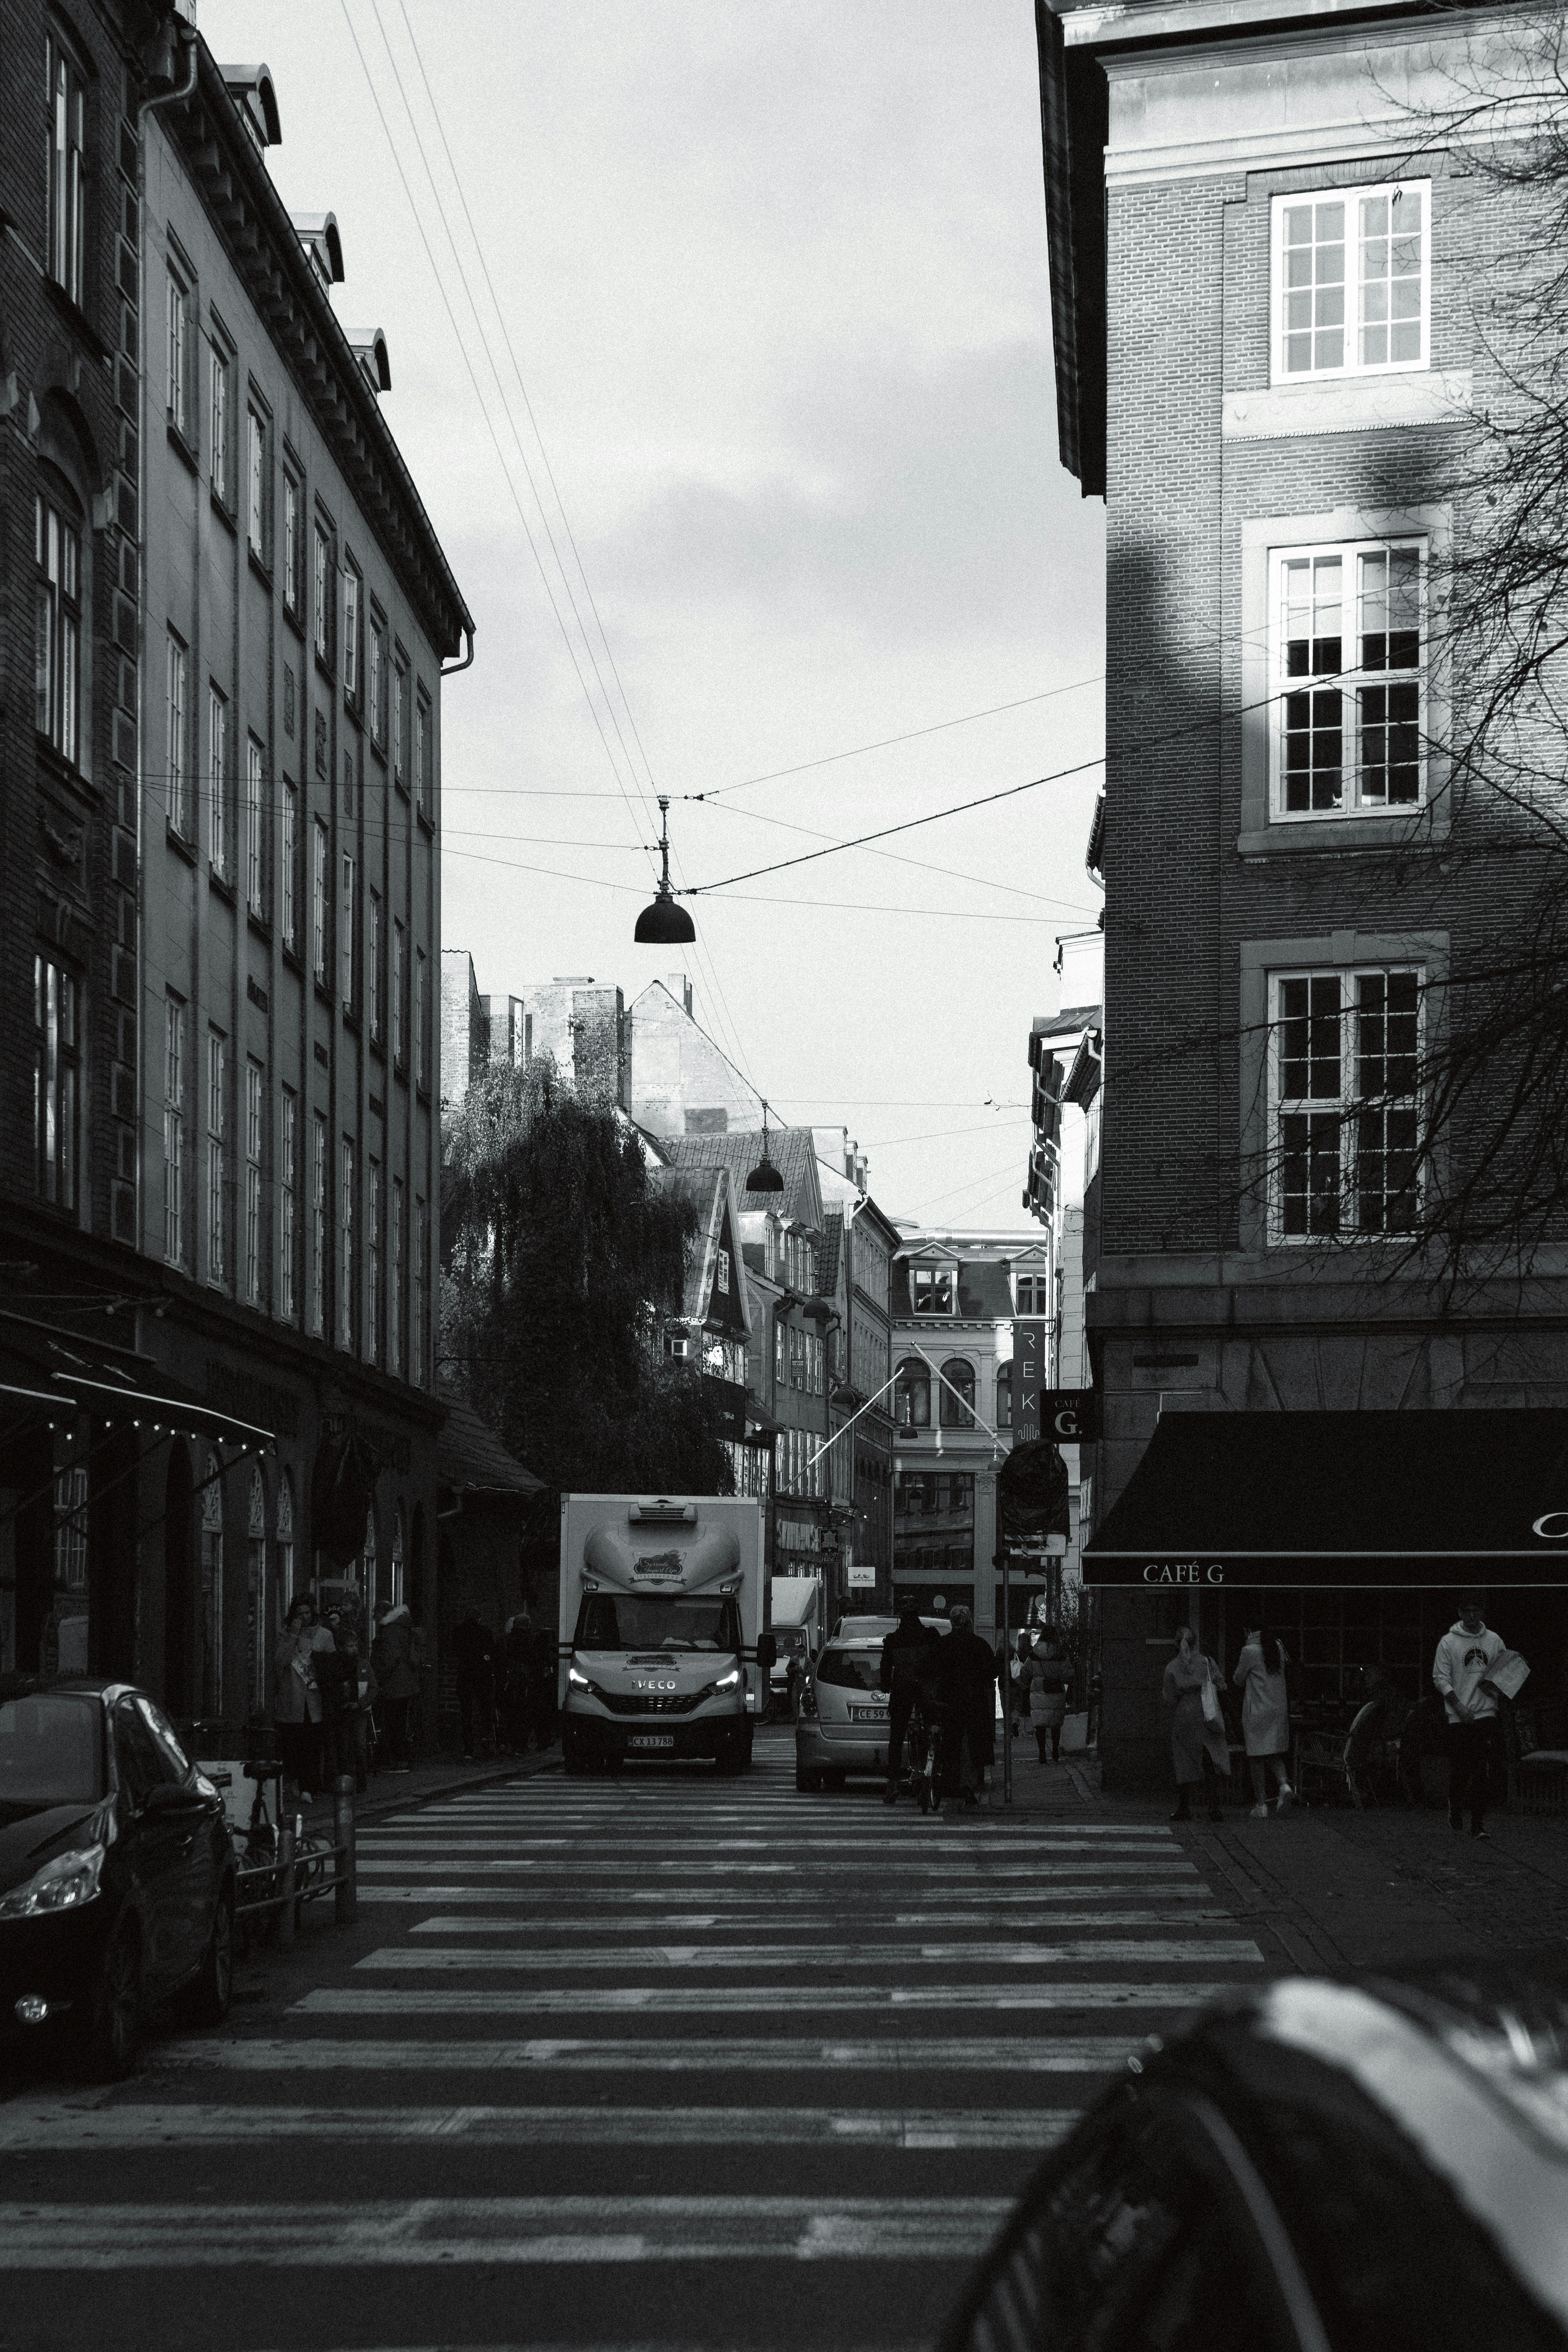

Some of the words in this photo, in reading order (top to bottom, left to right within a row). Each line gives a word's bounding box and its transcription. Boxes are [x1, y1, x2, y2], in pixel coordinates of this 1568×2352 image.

[1055, 1398, 1081, 1407] CAFÉ
[1143, 1561, 1200, 1582] CAFÉ
[1207, 1565, 1224, 1583] G
[632, 1680, 676, 1689] IVECO
[860, 1710, 871, 1718] CE
[874, 1710, 884, 1719] 59
